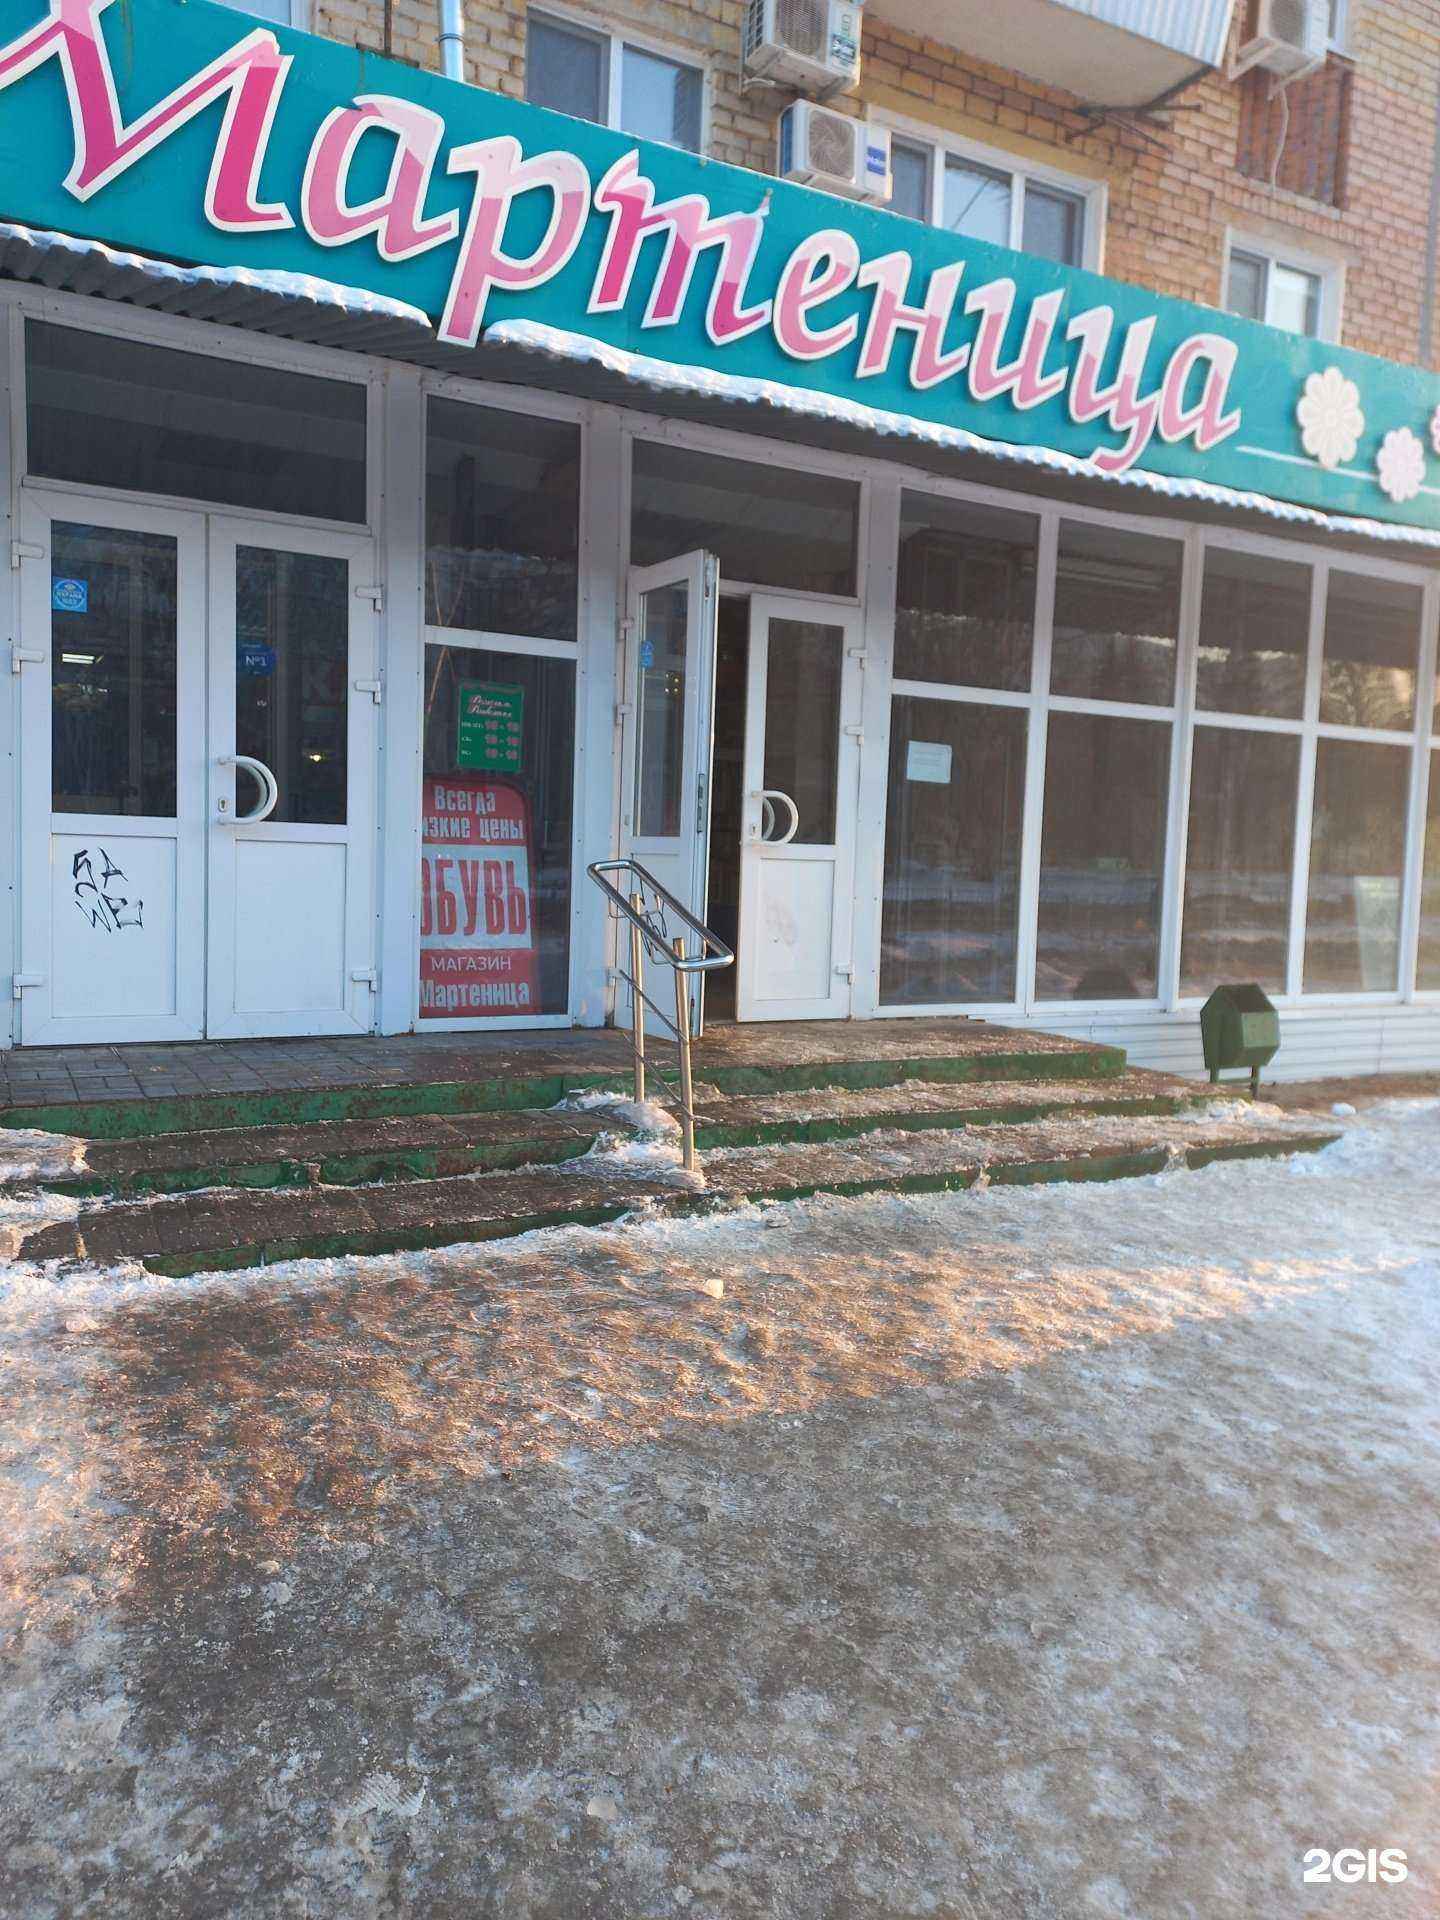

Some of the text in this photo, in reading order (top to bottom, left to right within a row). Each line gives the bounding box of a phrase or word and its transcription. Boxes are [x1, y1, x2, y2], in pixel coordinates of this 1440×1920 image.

[0, 0, 1242, 474] Мартеница
[435, 785, 496, 815] Всегда
[479, 817, 524, 842] цены
[431, 955, 512, 971] МАГАЗИН
[419, 979, 530, 1012] Мартеница
